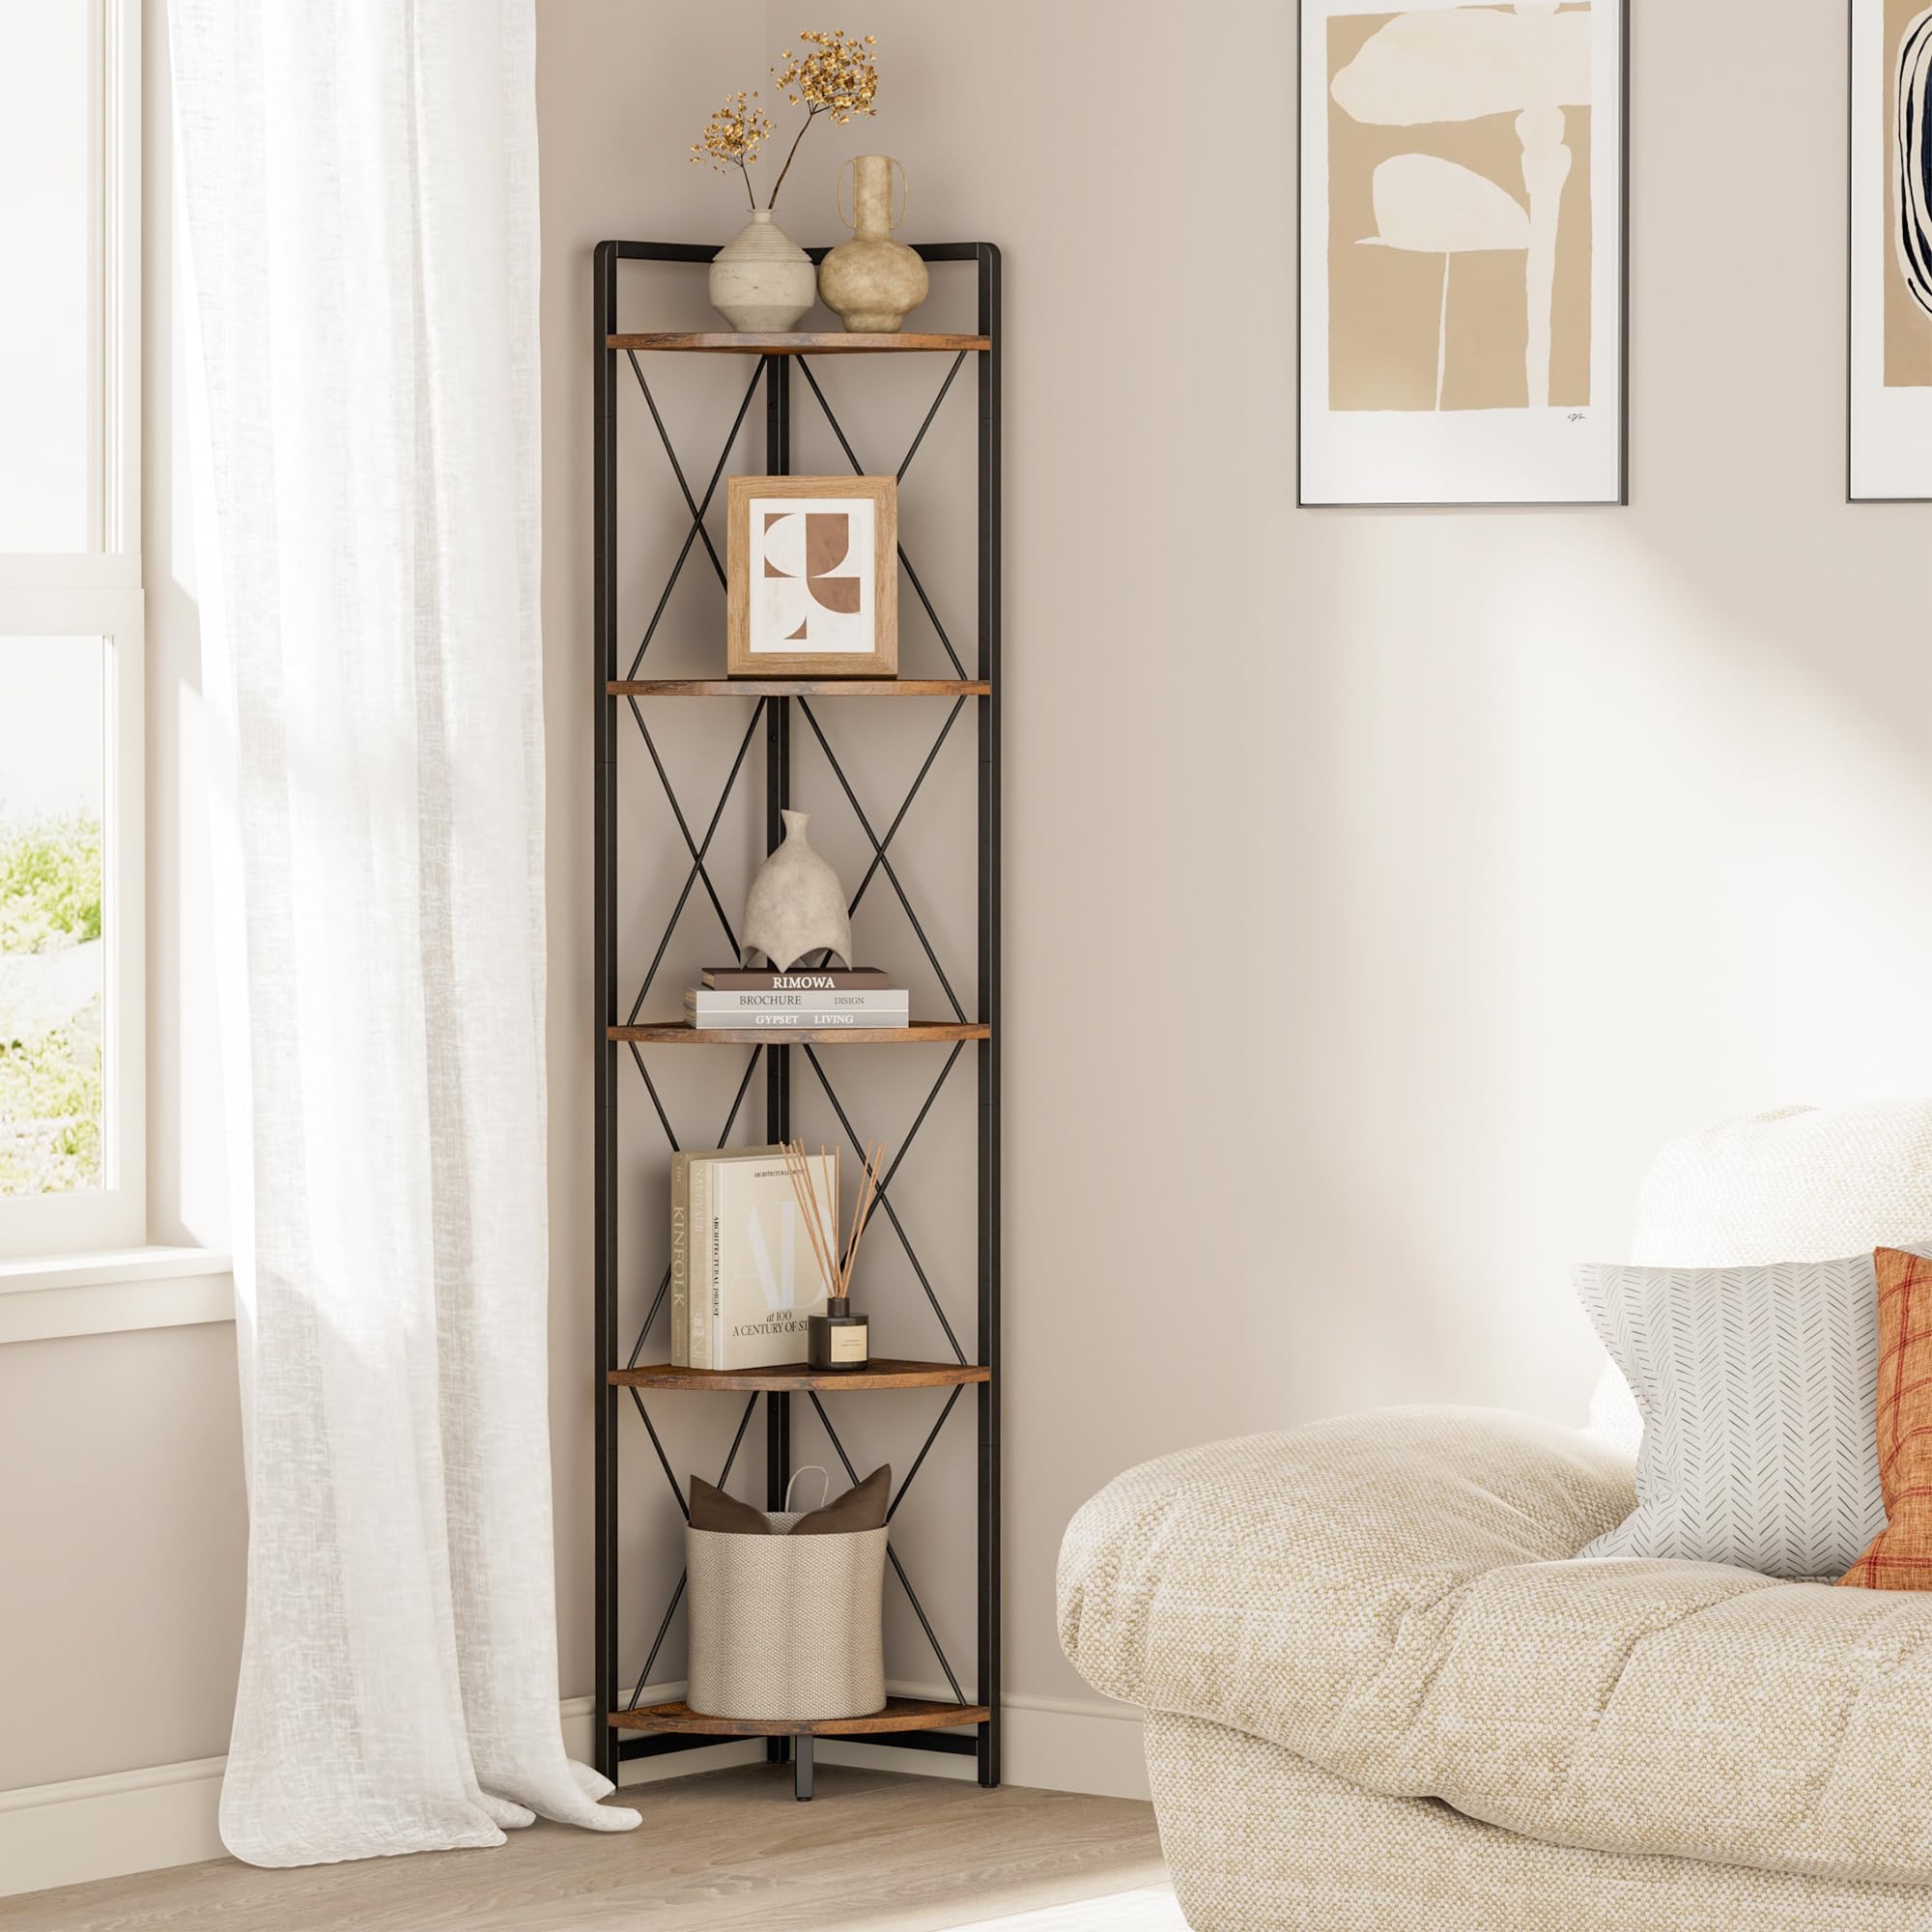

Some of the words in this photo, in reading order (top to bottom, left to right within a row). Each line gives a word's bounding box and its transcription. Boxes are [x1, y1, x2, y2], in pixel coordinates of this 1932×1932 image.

[773, 977, 836, 989] RIMOWA
[739, 995, 802, 1006] BROCHURE
[755, 1014, 799, 1025] GYPSET
[814, 1014, 854, 1025] LIVING
[673, 1207, 685, 1306] KINFOLK
[766, 1311, 775, 1322] at
[776, 1310, 792, 1321] 100
[732, 1325, 740, 1337] A
[740, 1321, 784, 1337] CENTURY
[784, 1321, 797, 1332] OF
[798, 1320, 809, 1332] ST
